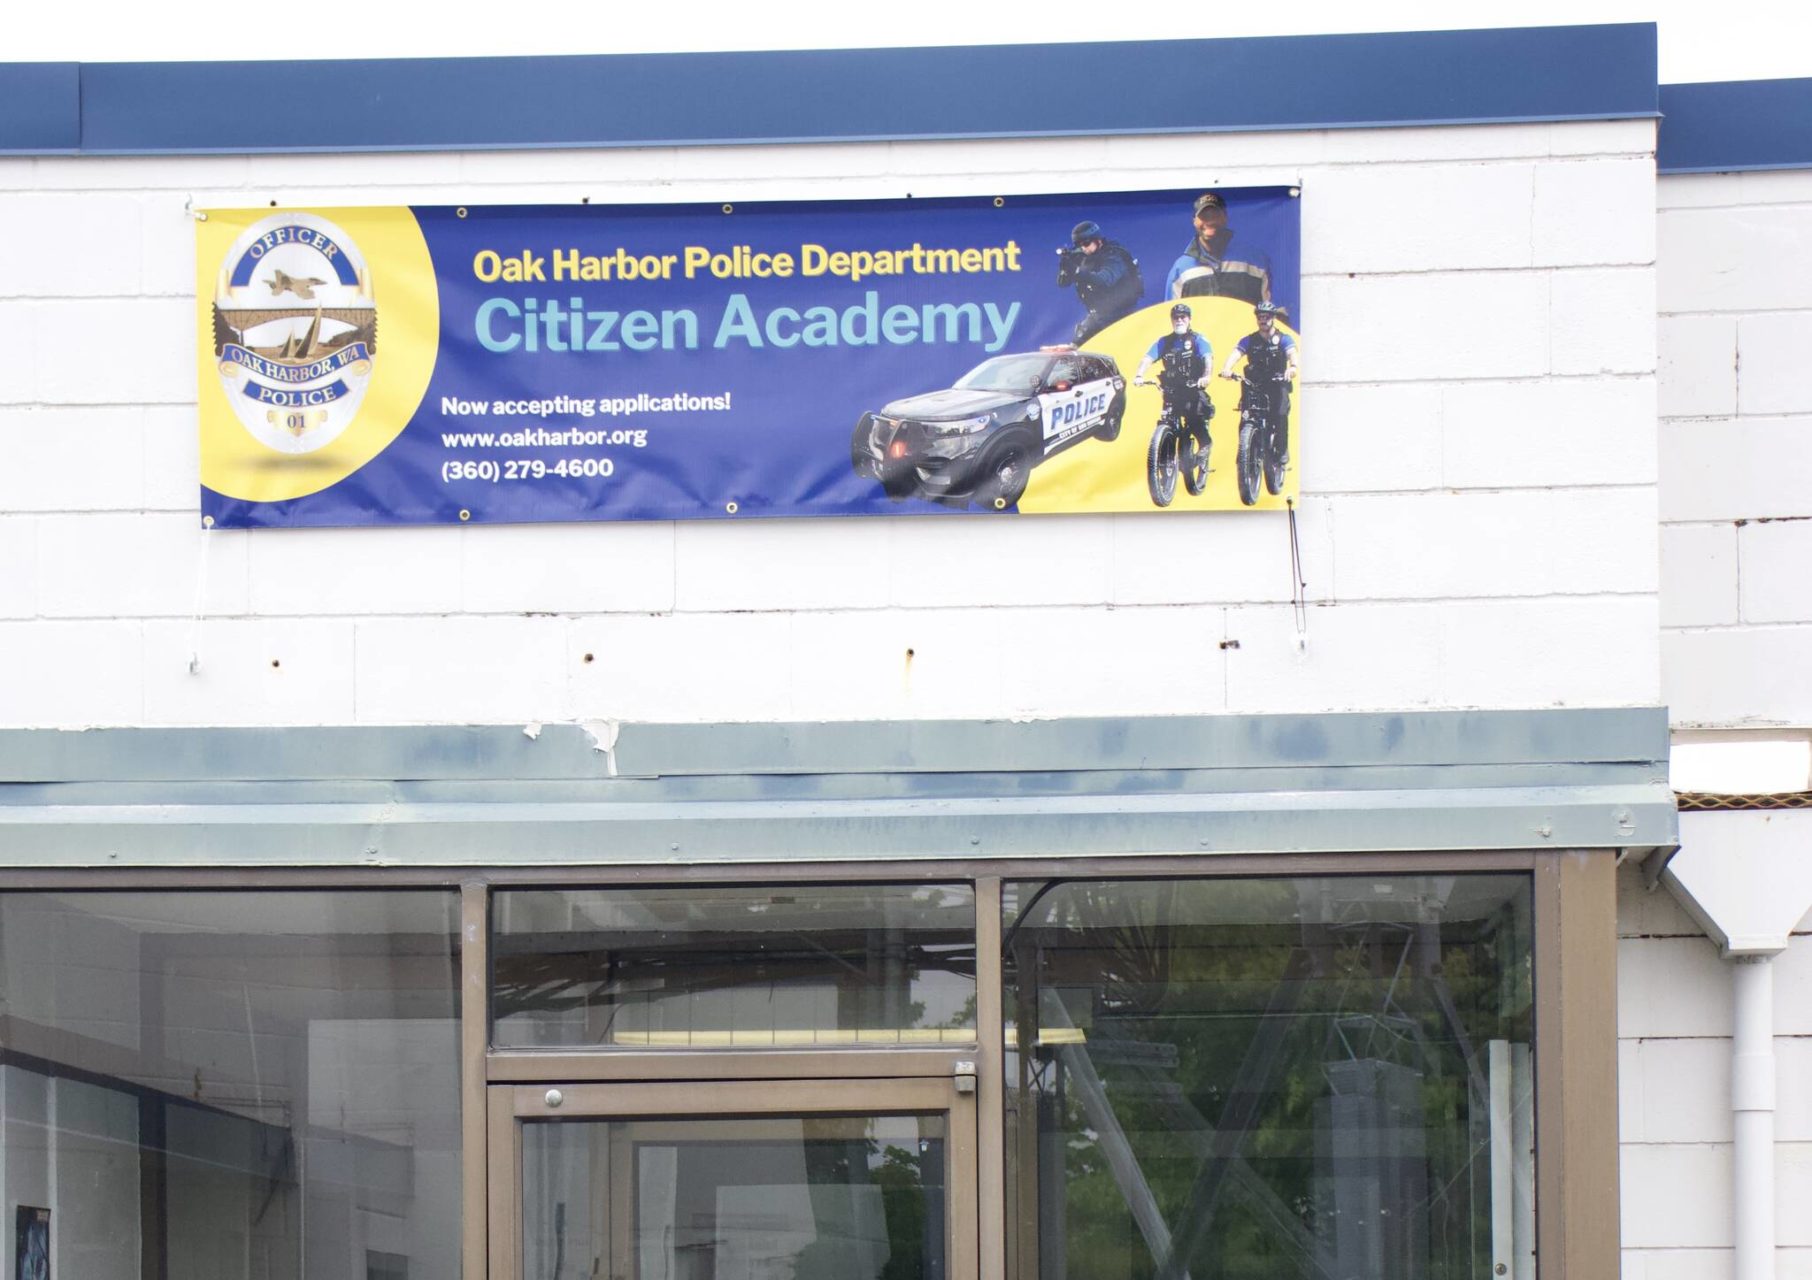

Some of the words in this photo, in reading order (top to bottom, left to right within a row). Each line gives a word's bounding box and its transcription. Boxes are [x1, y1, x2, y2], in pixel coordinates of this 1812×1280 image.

[250, 228, 338, 260] OFFICER
[473, 248, 546, 283] Oak
[553, 247, 678, 281] Harbor
[684, 245, 794, 279] Police
[801, 240, 1022, 282] Department
[474, 296, 699, 353] Citizen
[712, 290, 1022, 353] Academy
[231, 349, 263, 371] OAK
[266, 359, 335, 382] HARBOR,
[338, 346, 359, 365] WA
[259, 387, 336, 406] POLICE
[441, 396, 488, 415] Now
[492, 395, 596, 417] accepting
[599, 392, 731, 416] applications!
[287, 415, 306, 429] 01
[1050, 393, 1106, 430] POLICE
[441, 427, 648, 448] www.oakharbor.org
[441, 460, 501, 482] (360)
[504, 458, 614, 480] 279-4600
